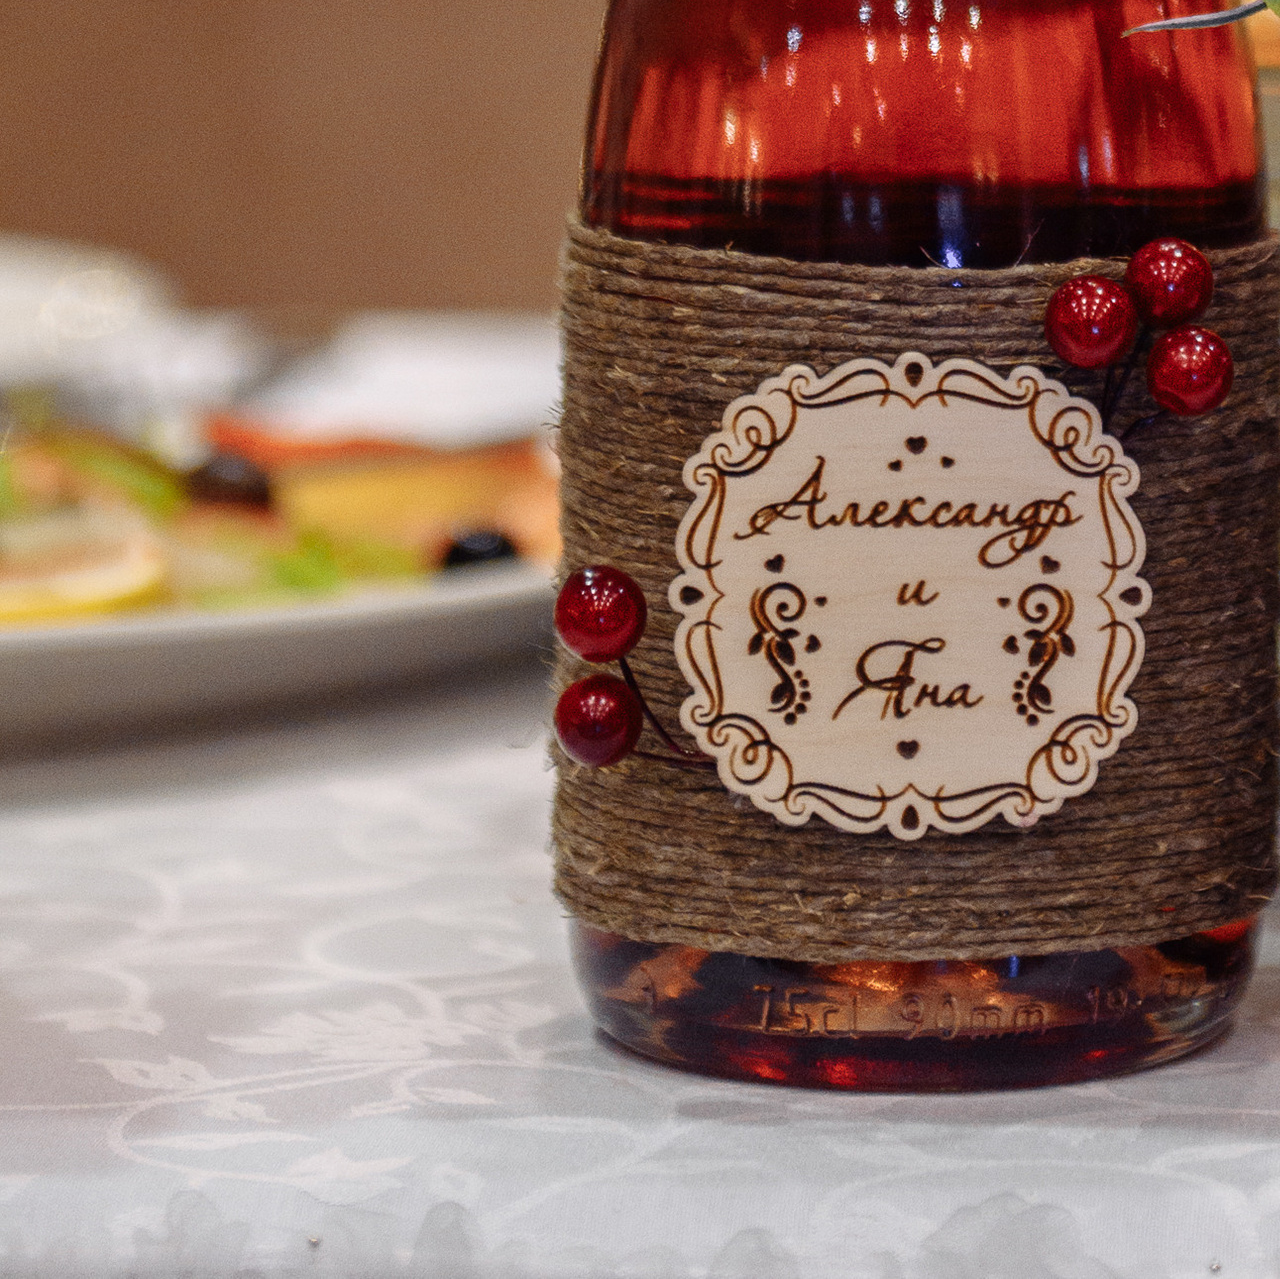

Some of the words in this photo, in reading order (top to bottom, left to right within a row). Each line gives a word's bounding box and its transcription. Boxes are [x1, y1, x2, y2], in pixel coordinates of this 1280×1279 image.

[733, 455, 1083, 569] Александр
[896, 579, 940, 607] и
[832, 637, 985, 721] Яна
